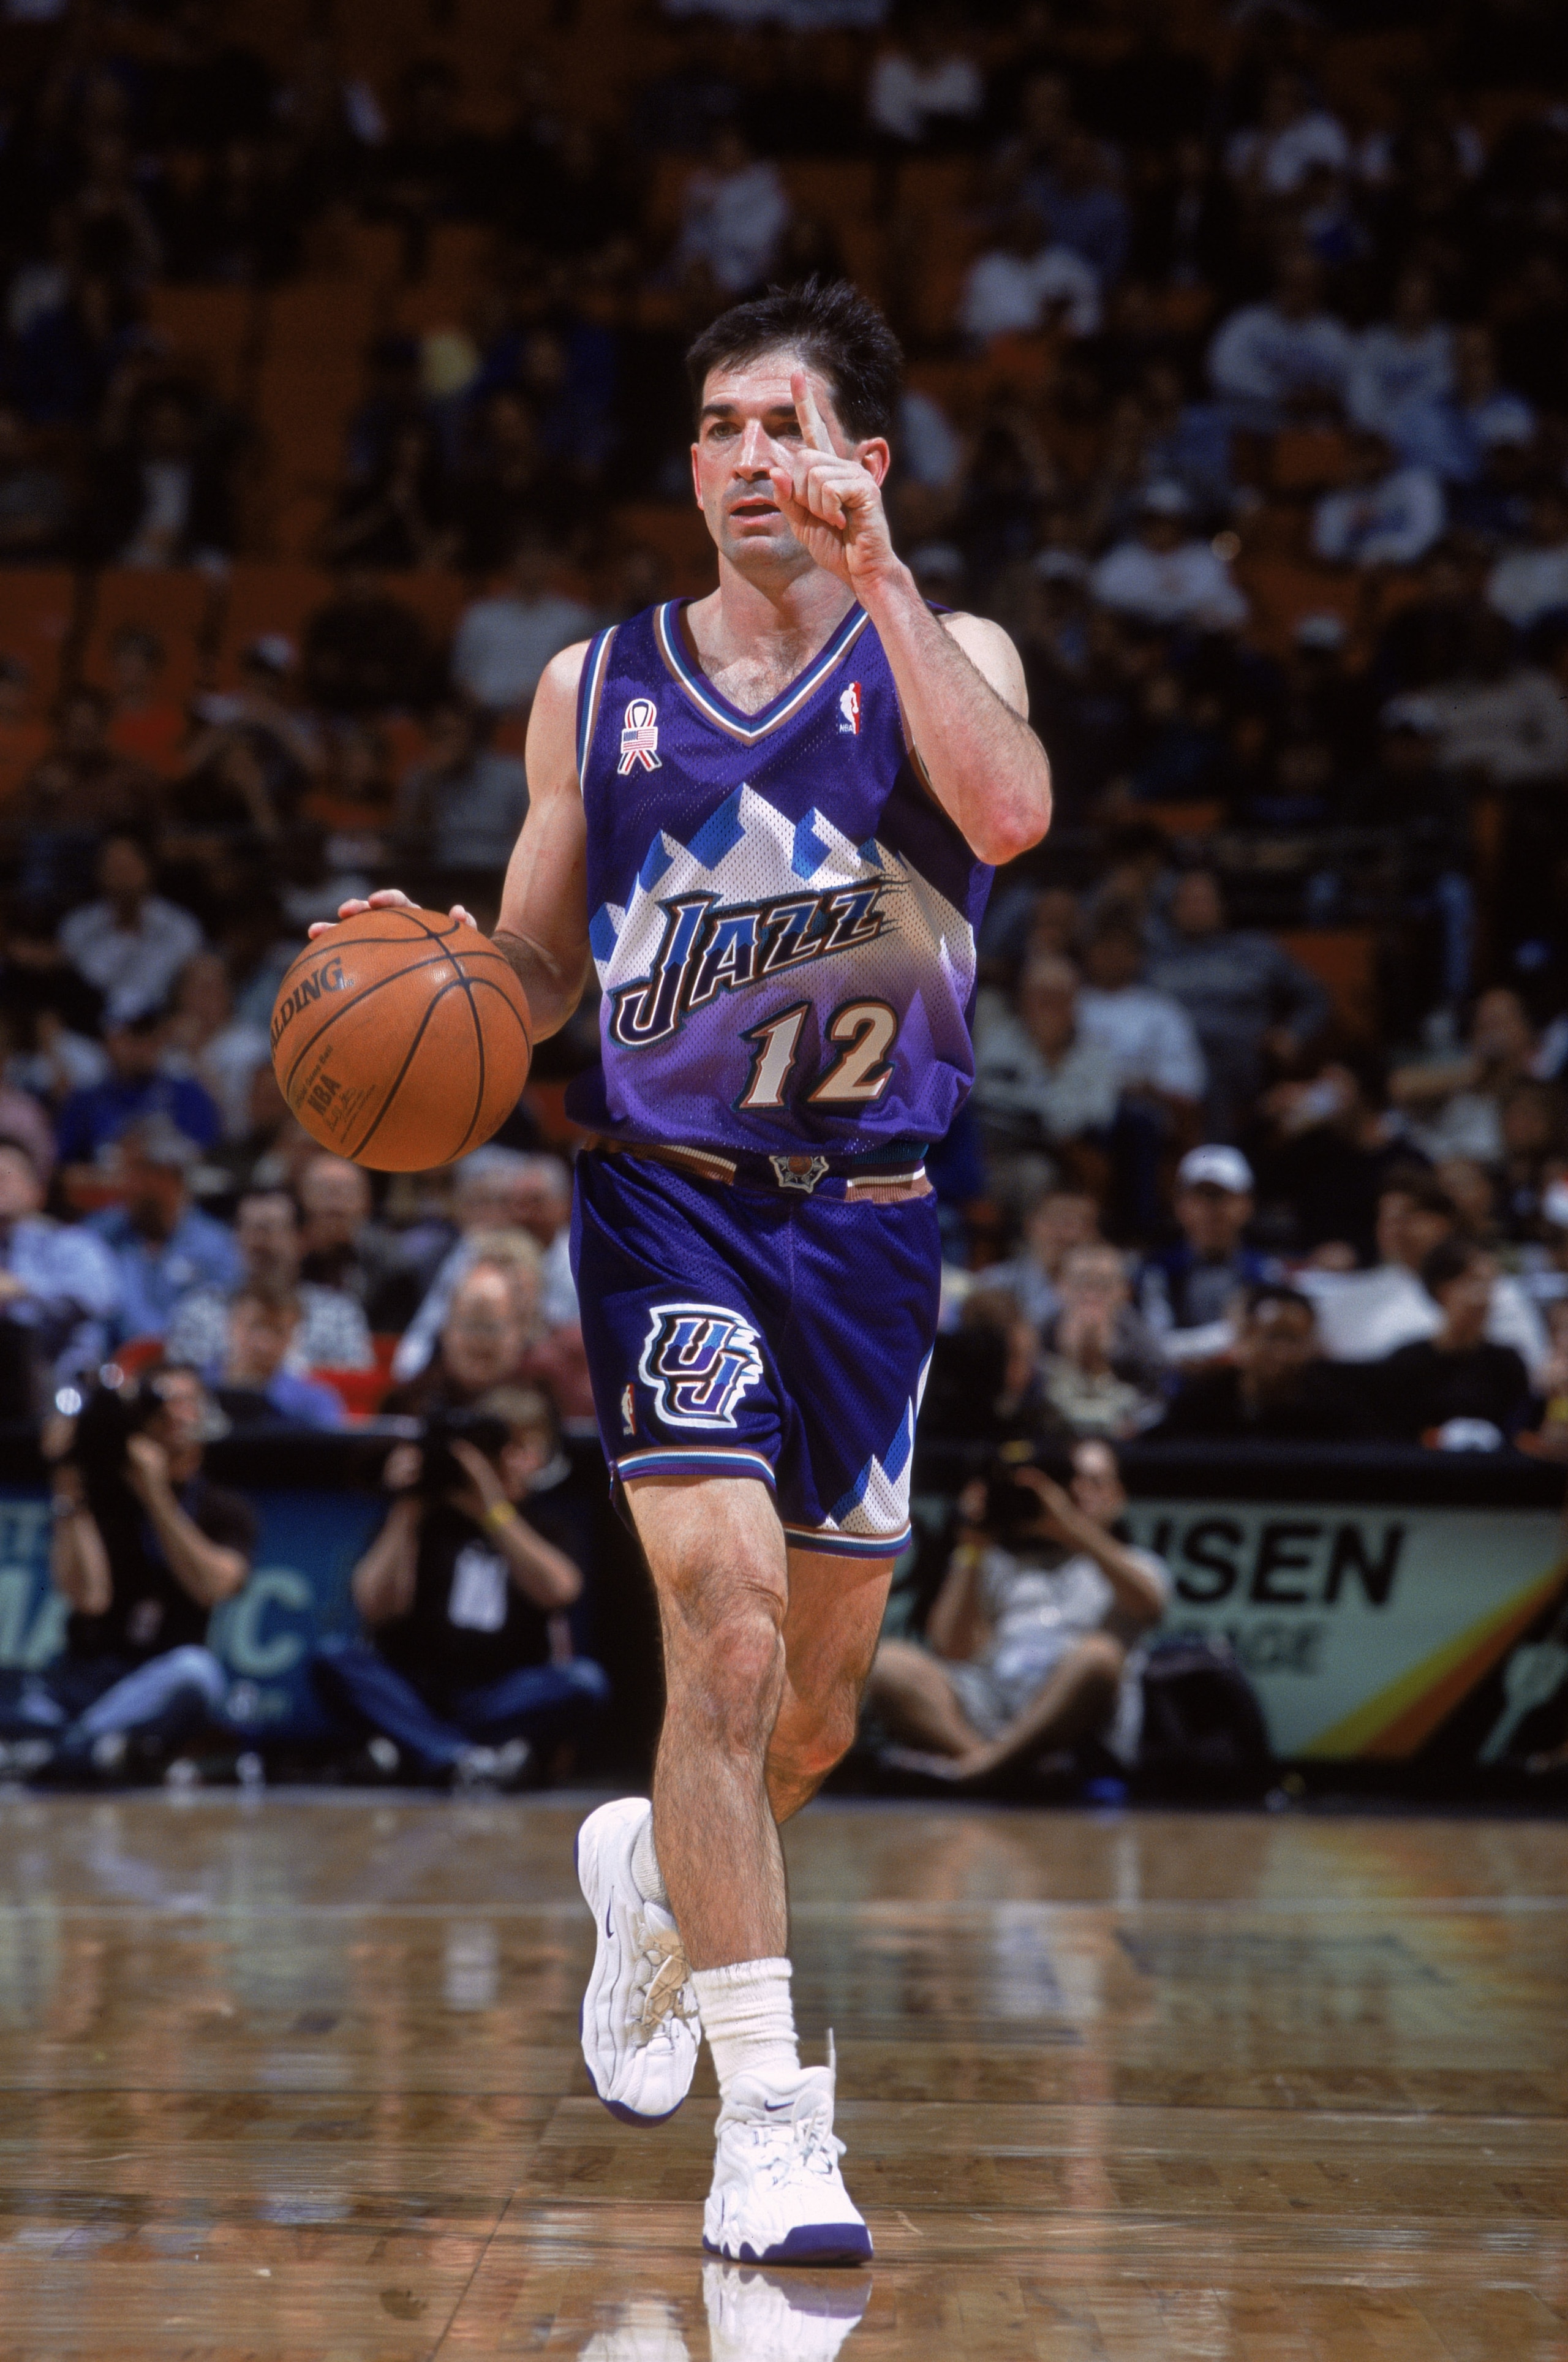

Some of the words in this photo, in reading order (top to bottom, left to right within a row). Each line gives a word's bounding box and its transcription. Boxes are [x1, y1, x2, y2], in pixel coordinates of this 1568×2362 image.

[839, 723, 854, 733] NBA
[733, 998, 896, 1112] 12
[307, 1074, 342, 1116] NBA
